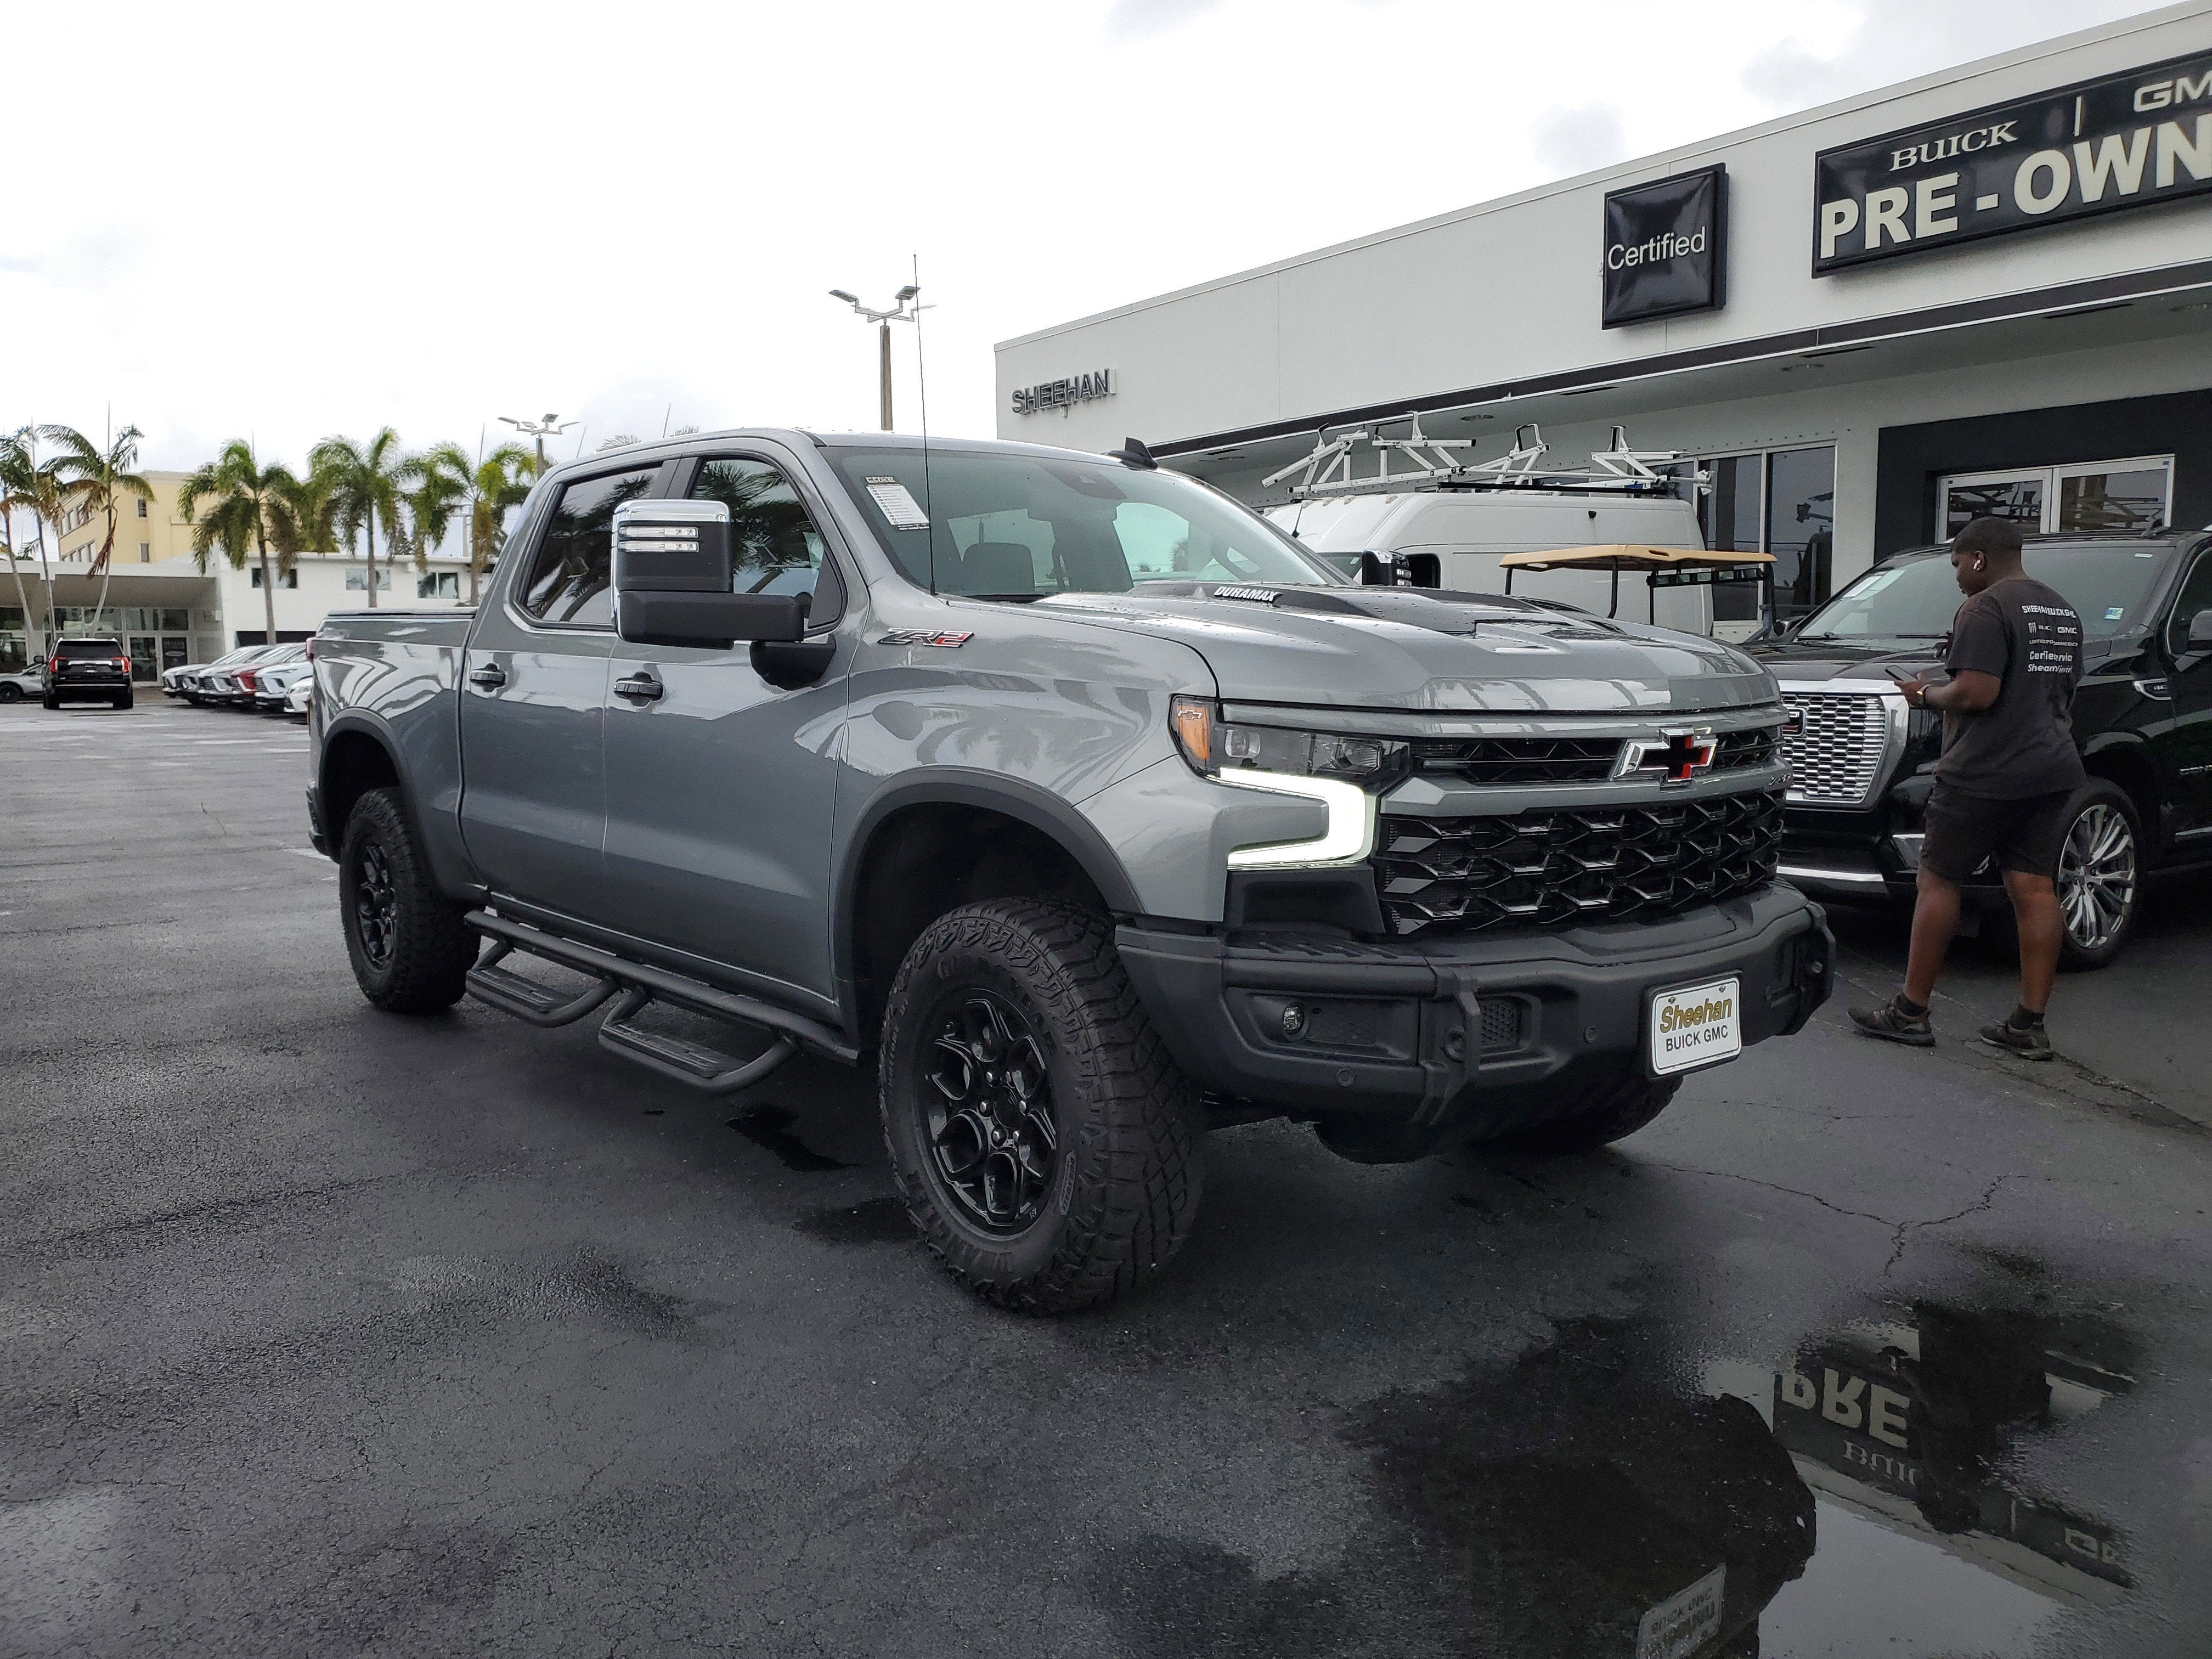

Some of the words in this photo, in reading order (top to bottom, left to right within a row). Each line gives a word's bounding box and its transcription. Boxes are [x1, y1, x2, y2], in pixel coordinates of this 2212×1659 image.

[1889, 120, 2019, 172] BUICK
[1820, 171, 1960, 259] PRE
[1608, 225, 1706, 270] Certified
[1011, 368, 1110, 414] SHEEHAN
[1214, 586, 1283, 603] DURAMAX
[878, 628, 974, 648] ZR2
[1660, 998, 1733, 1034] Sheehan
[1666, 1031, 1701, 1052] BUICK
[1703, 1025, 1728, 1042] GMC
